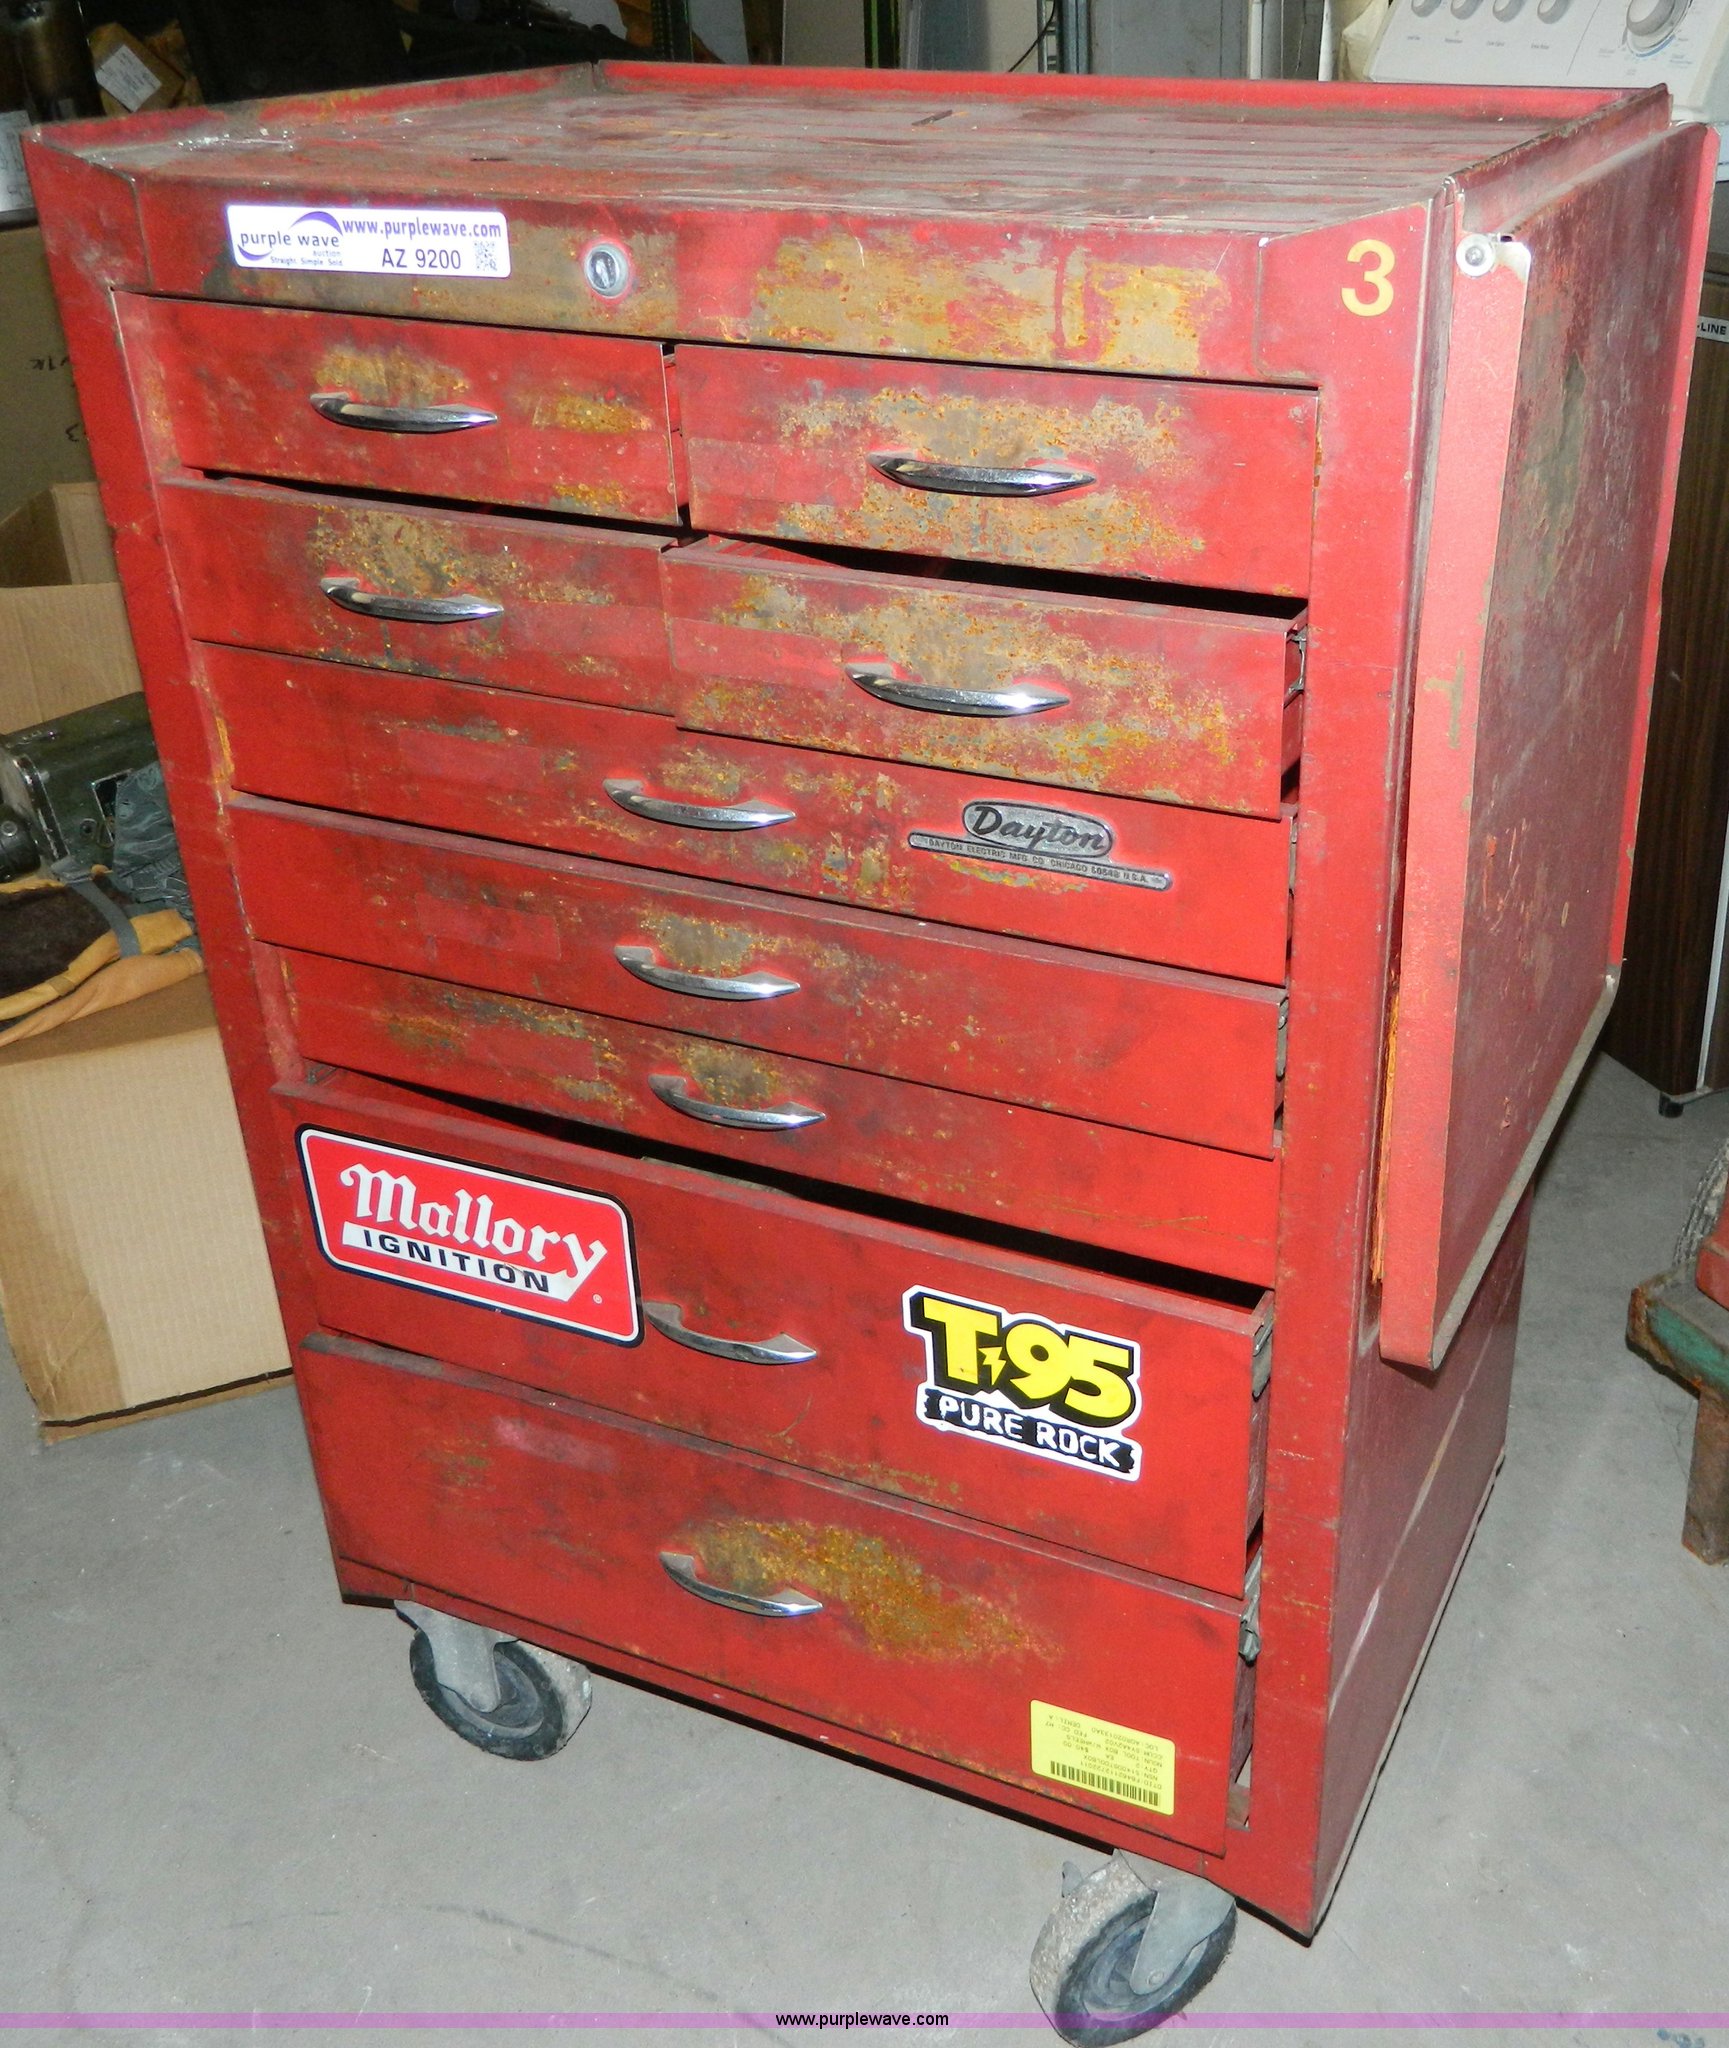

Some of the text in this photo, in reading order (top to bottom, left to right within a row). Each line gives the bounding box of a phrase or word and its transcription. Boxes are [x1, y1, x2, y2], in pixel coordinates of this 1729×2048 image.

[240, 231, 340, 249] purple wave
[342, 217, 502, 240] www.purplewave.com
[381, 248, 462, 270] AZ 9200
[1341, 238, 1396, 317] 3
[972, 805, 1107, 851] Dayton
[929, 838, 962, 851] DAYTON
[967, 845, 1006, 858] ELECTRIC
[1050, 859, 1088, 873] CHICAGO
[340, 1163, 608, 1281] Mallory
[364, 1229, 549, 1294] IGNITION
[937, 1395, 1121, 1468] PURE ROCK
